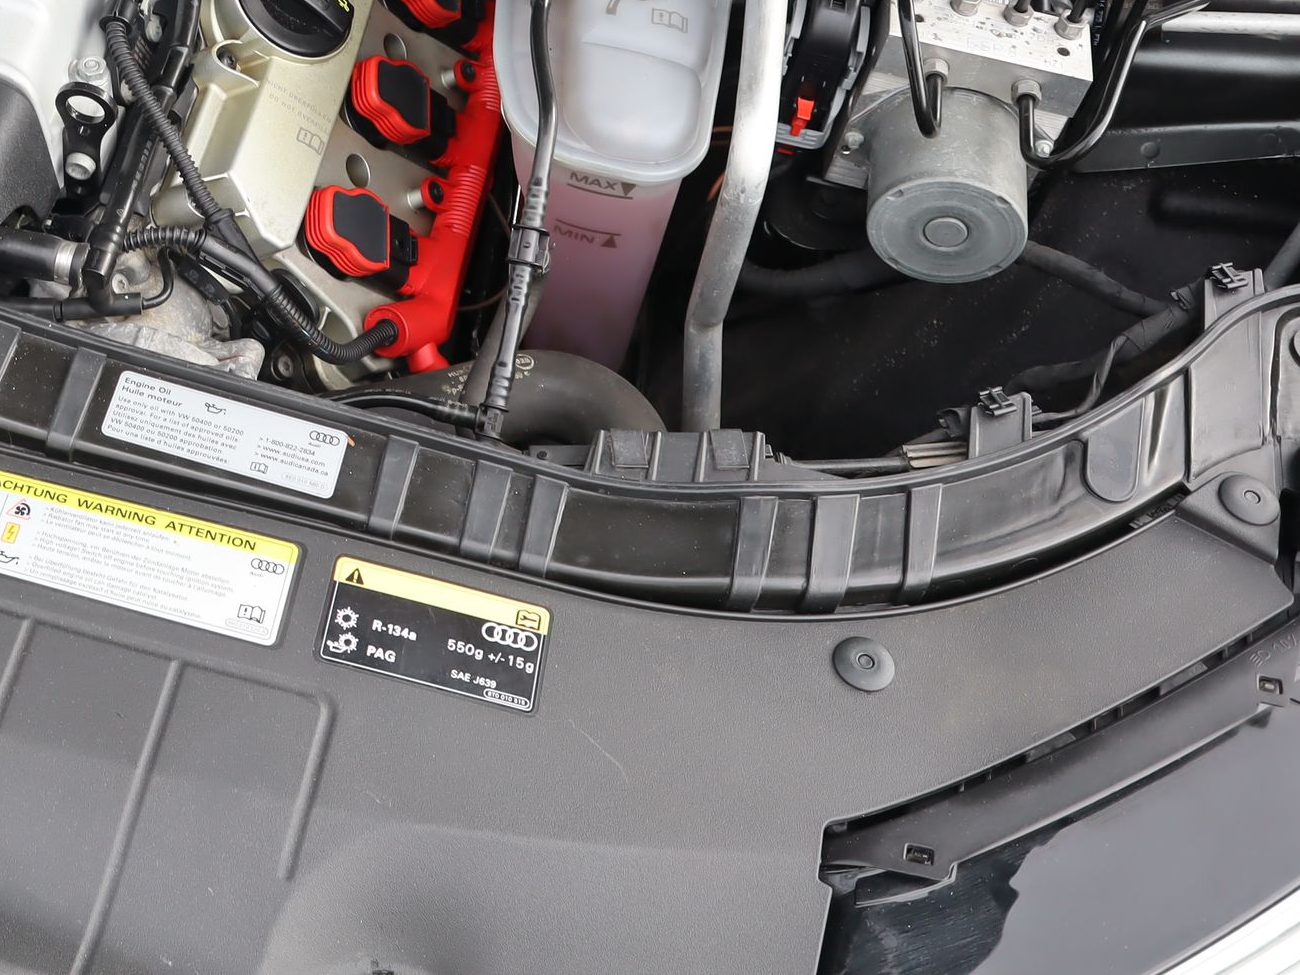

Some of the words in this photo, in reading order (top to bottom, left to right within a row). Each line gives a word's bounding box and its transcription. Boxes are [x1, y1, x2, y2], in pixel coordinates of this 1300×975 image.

[570, 172, 618, 191] MAX
[553, 225, 595, 244] MIN
[121, 385, 144, 396] Huile
[147, 392, 182, 406] moteur
[124, 377, 155, 390] Engine
[158, 386, 171, 394] Oil
[77, 498, 156, 526] WARNING
[165, 521, 256, 551] ATTENTION
[371, 619, 418, 642] R-134a
[366, 645, 397, 664] PAG
[447, 639, 484, 661] 550g
[450, 669, 472, 684] SAE
[473, 675, 497, 689] J639
